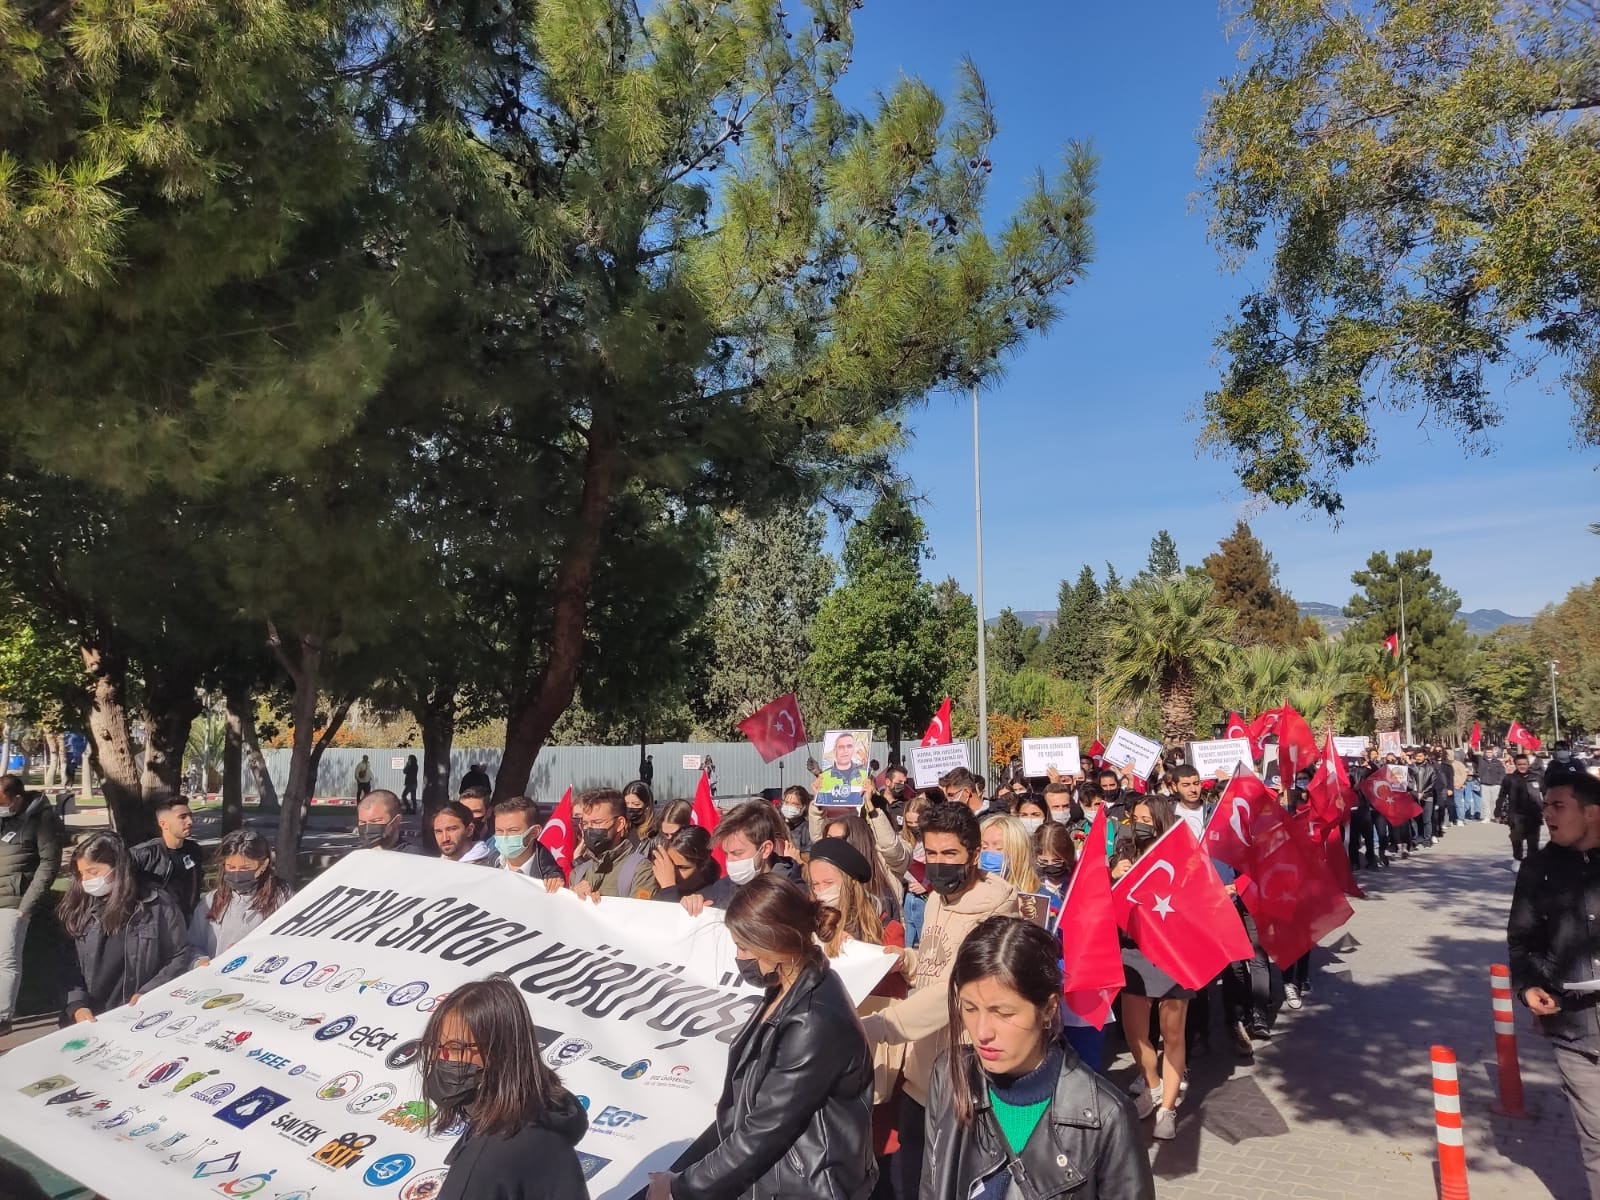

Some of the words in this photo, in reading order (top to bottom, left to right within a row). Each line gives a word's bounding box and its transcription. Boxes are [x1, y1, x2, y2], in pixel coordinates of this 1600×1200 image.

[270, 885, 426, 943] ATA'YA
[375, 897, 542, 967] SAYGI
[255, 1051, 291, 1070] IEEE
